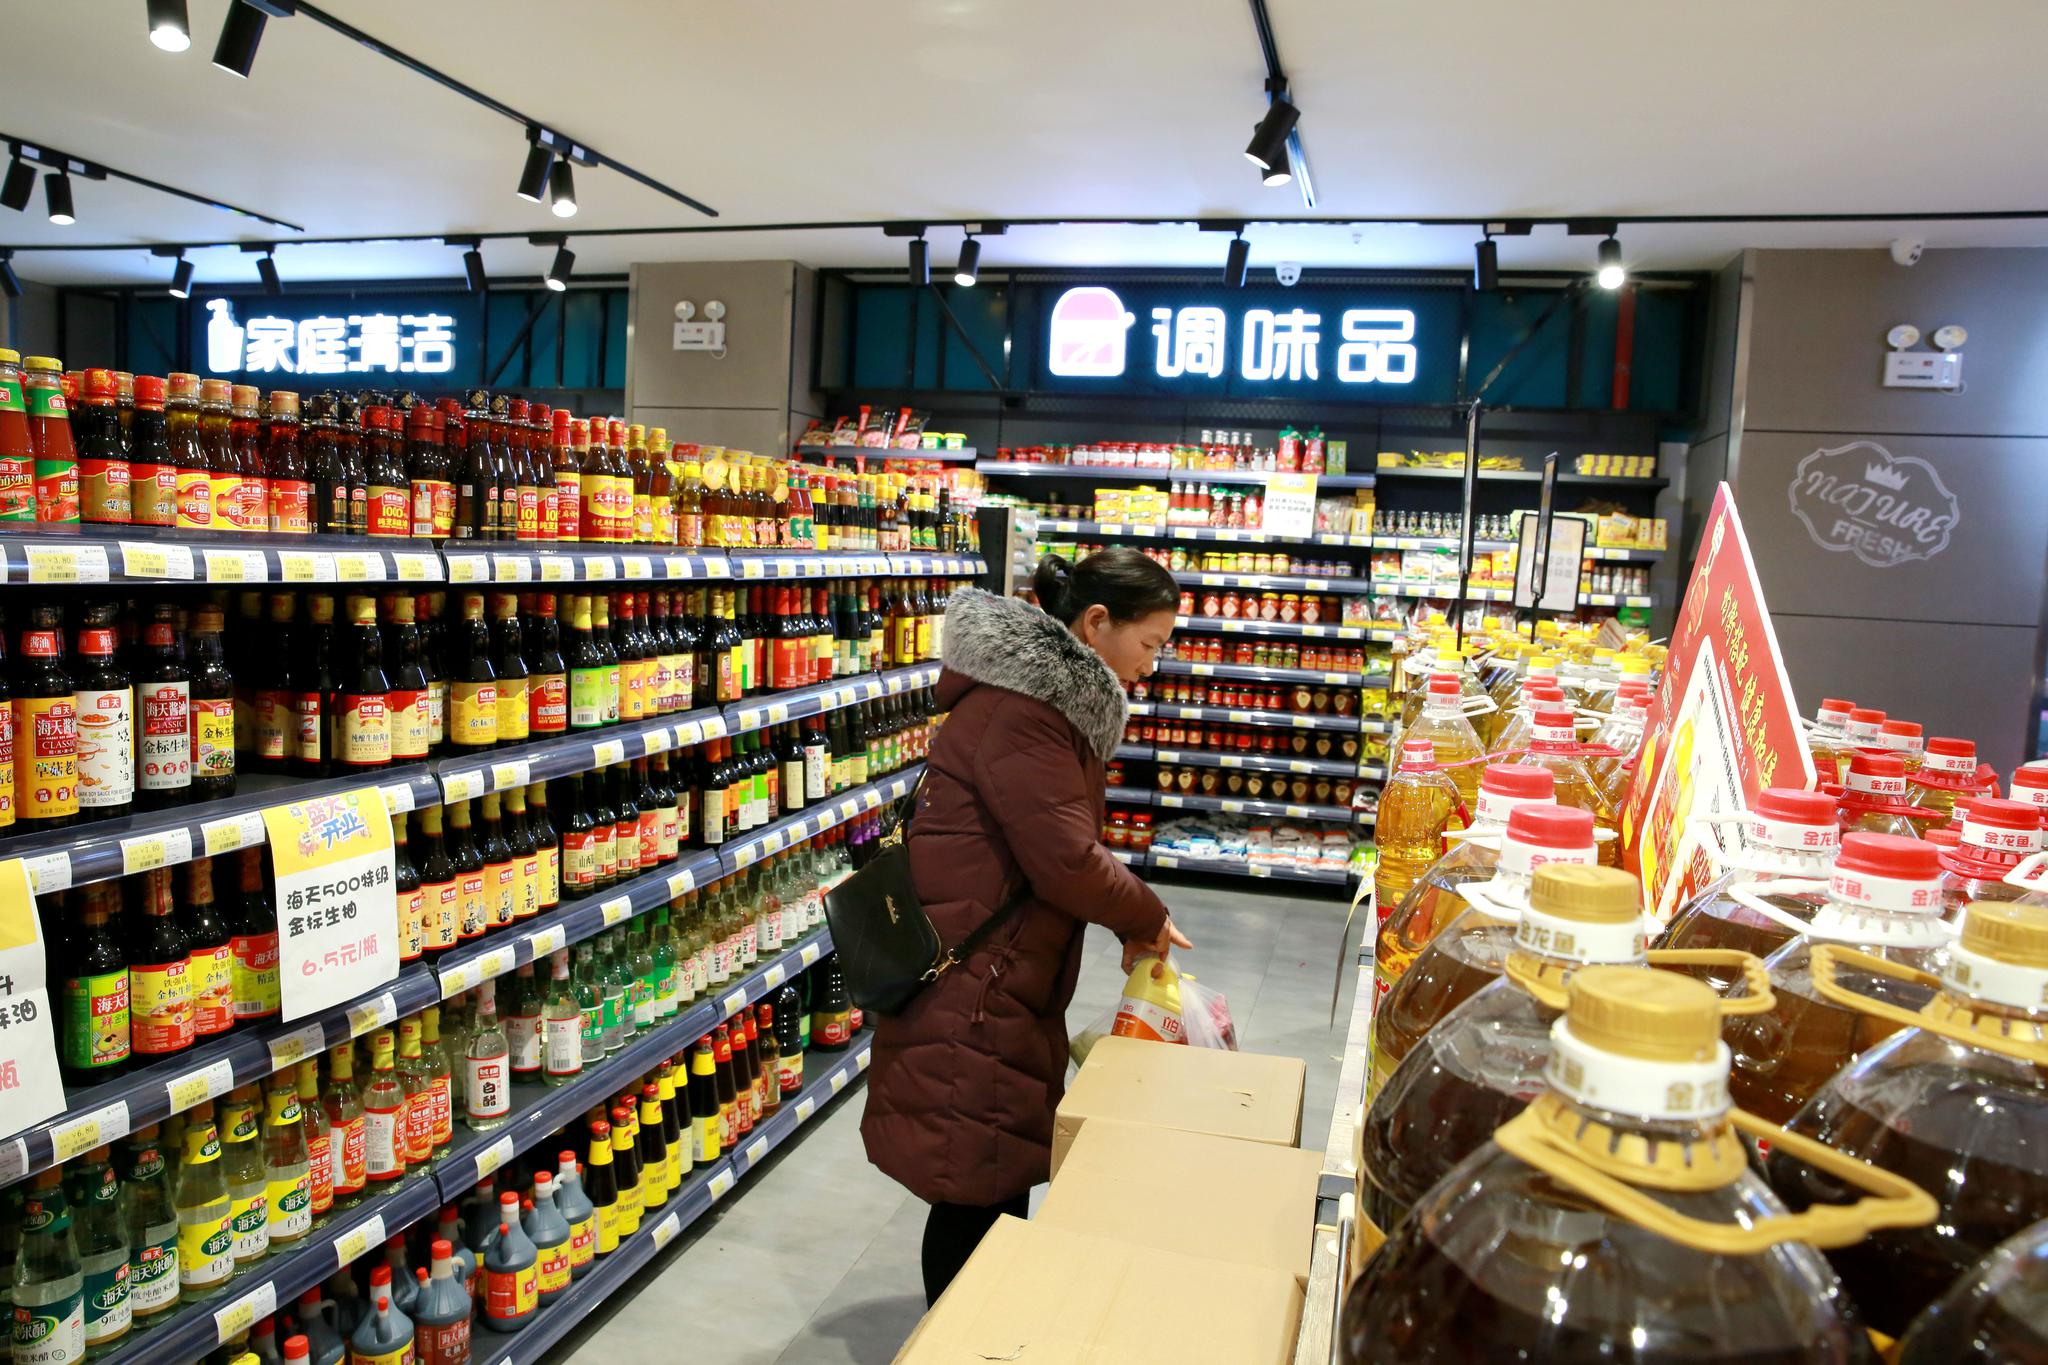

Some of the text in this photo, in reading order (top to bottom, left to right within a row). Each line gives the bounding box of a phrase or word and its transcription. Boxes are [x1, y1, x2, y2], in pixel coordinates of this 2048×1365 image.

[246, 313, 456, 374] 家庭清洁
[1151, 307, 1416, 384] 调味品
[1831, 520, 1912, 559] FRESH
[159, 690, 178, 699] 海天
[52, 706, 71, 716] 海天
[99, 699, 120, 709] 海天
[146, 701, 187, 718] 海天酱油
[37, 717, 77, 737] 海天酱
[150, 719, 185, 729] CLASSIC
[36, 760, 77, 778] 草菇老
[1870, 779, 1904, 792] 金龙鱼
[320, 812, 365, 848] 开业
[1984, 831, 2031, 848] 金龙鱼
[286, 865, 389, 911] 海天500特级
[288, 900, 357, 938] 金标生抽
[302, 933, 379, 977] 6.5元/瓶
[167, 965, 185, 977] 海天
[482, 1081, 497, 1107] 白醋
[143, 1248, 163, 1260] 海天
